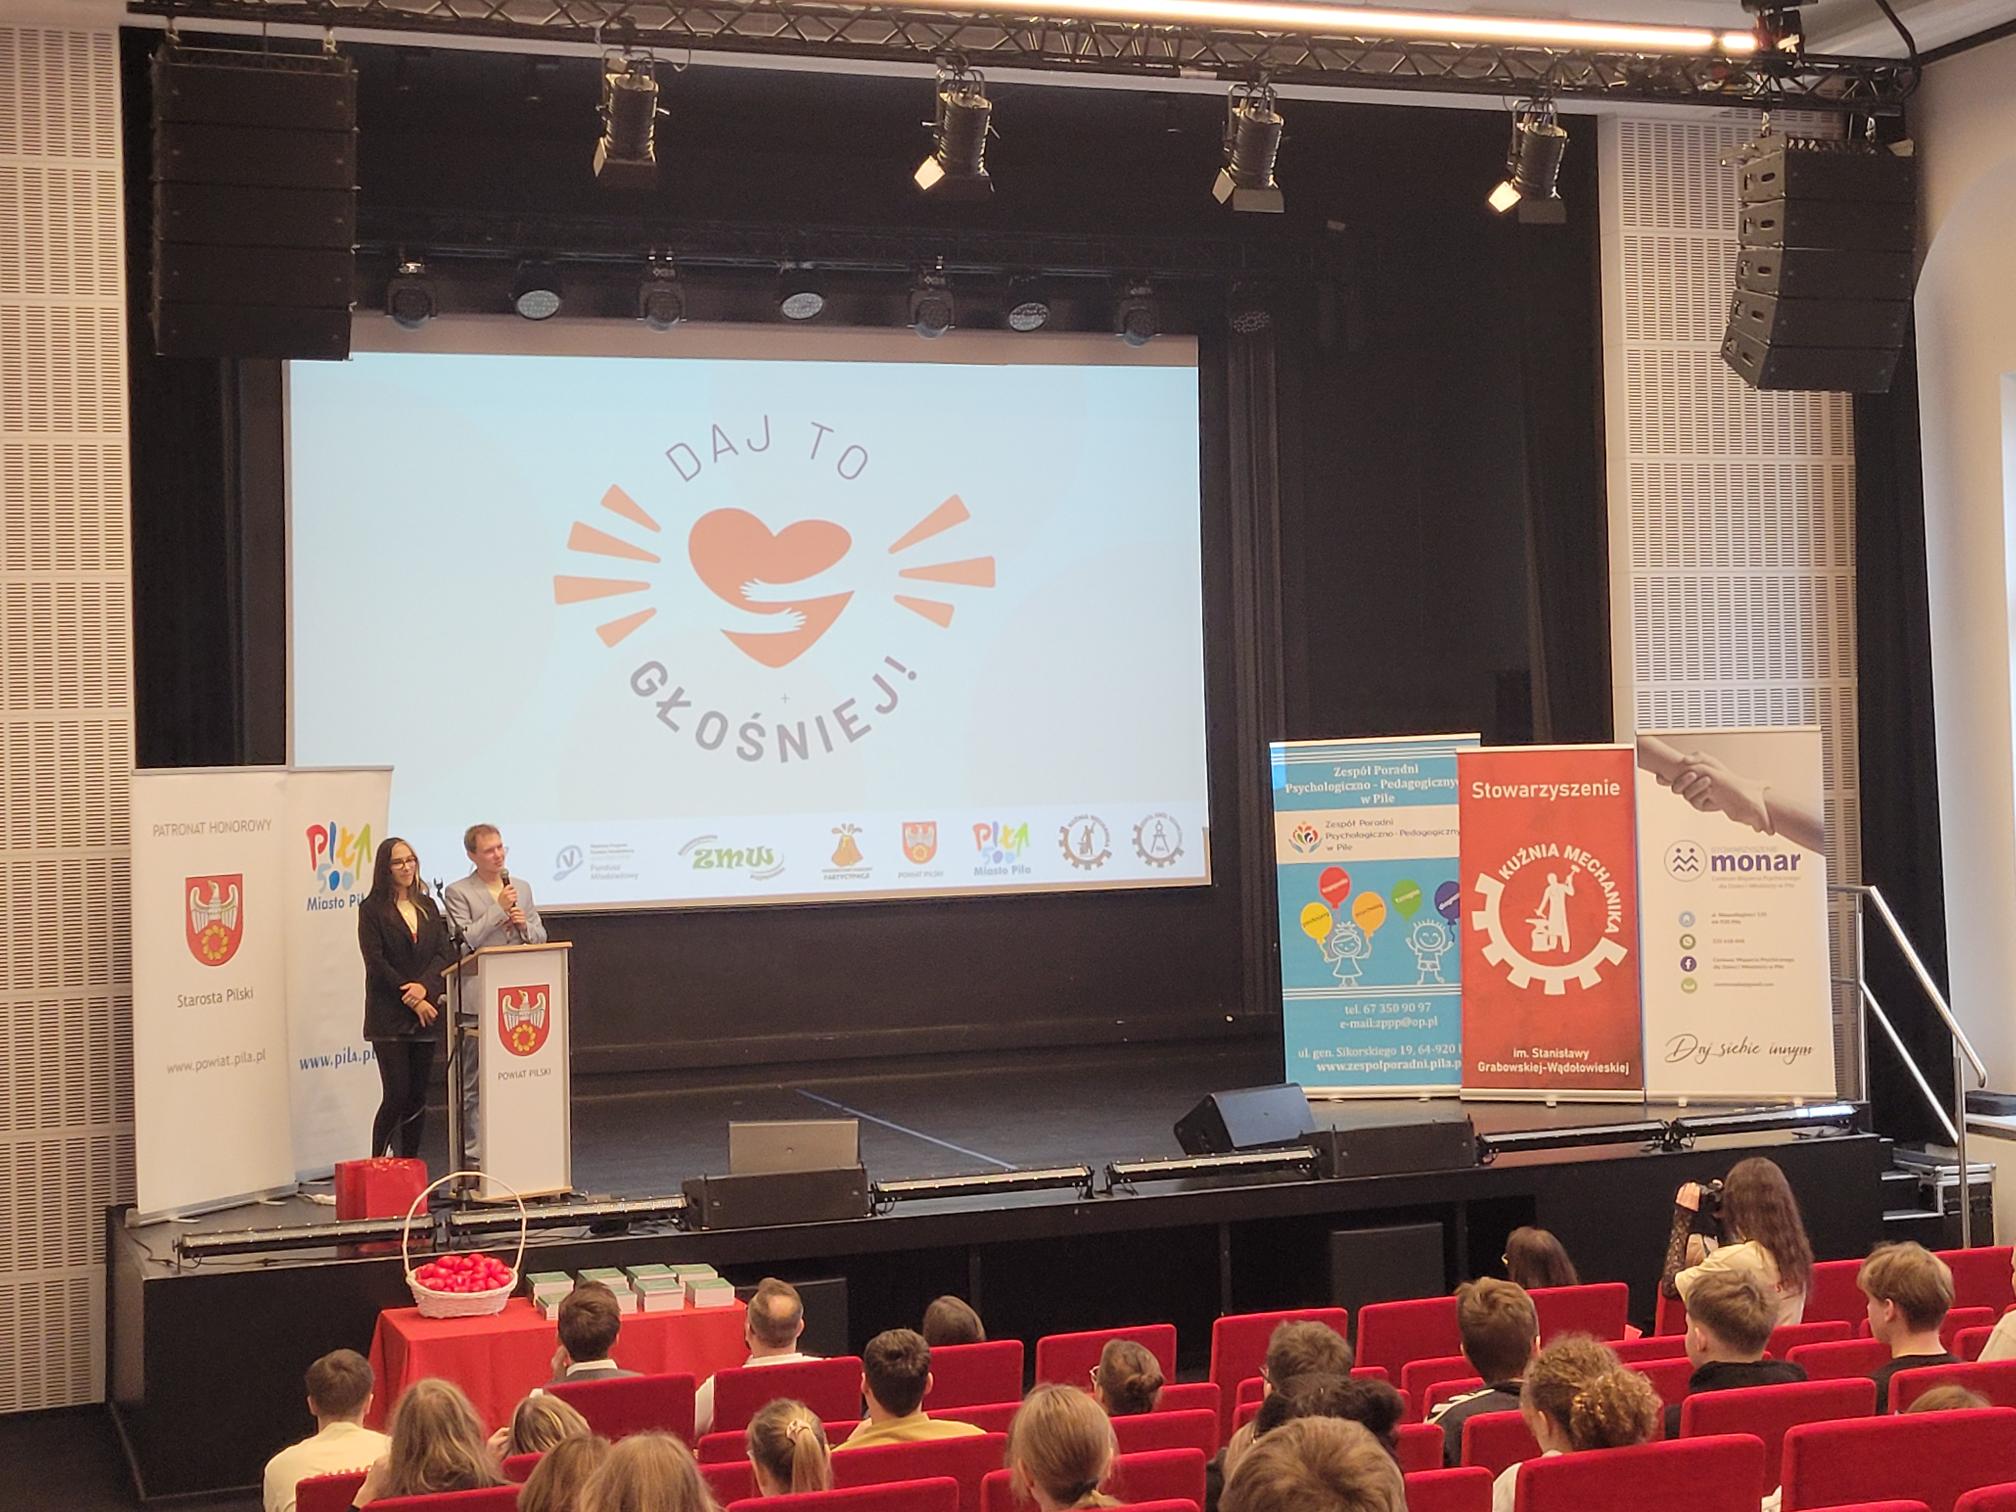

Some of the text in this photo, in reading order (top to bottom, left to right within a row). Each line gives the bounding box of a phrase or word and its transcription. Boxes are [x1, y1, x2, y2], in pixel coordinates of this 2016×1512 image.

[665, 414, 869, 482] DAJ TO
[630, 655, 918, 763] GŁOŚNIEJ!
[1374, 763, 1418, 775] Poradni
[1285, 781, 1371, 795] Psychologiczno
[1472, 778, 1620, 801] Stowarzyszenie
[1360, 793, 1395, 804] w Pile
[152, 819, 271, 837] PATRONAT HONOROWY
[1359, 817, 1394, 826] Poradni
[974, 866, 1009, 876] Miasto
[1711, 853, 1801, 872] monar
[1498, 843, 1622, 934] KUŹNIA MECHANIKA
[306, 894, 345, 911] Miasto
[177, 986, 254, 1008] Starosta Pilski
[1363, 1004, 1377, 1014] 67
[1380, 1003, 1400, 1013] 350
[1401, 1003, 1416, 1013] 90
[1418, 1002, 1432, 1012] 97
[1336, 1046, 1397, 1058] Sikorskiego
[1417, 1044, 1456, 1056] 64-920
[1513, 1047, 1590, 1060] im. Stanisławy
[1664, 1033, 1713, 1065] Daj
[1769, 1043, 1813, 1065] innym
[167, 1049, 266, 1074] www.powiat.pila.pl
[497, 1068, 551, 1080] POWIAT PILSKI
